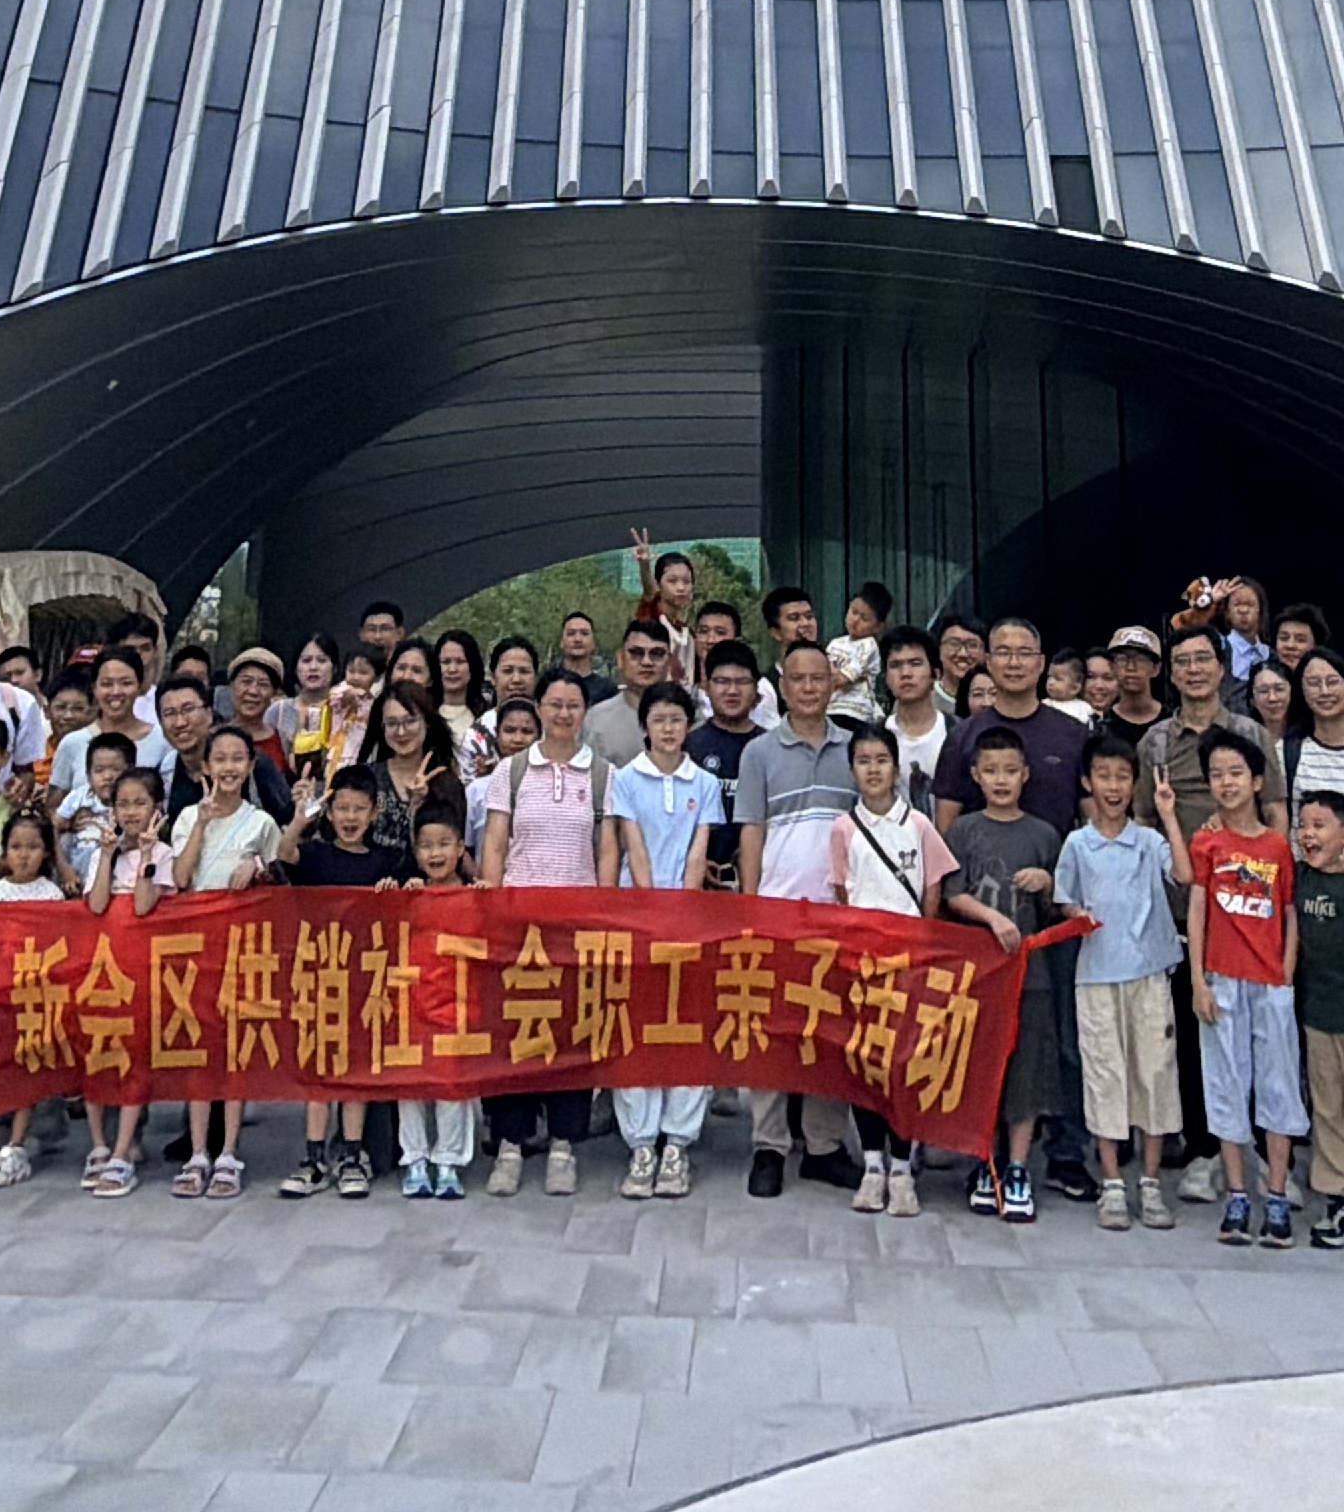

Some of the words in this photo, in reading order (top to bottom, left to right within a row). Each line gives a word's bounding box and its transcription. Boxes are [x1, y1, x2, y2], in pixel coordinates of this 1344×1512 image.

[1304, 898, 1337, 917] NIKE
[10, 920, 979, 1114] 新会区供销社工会职工亲子活动
